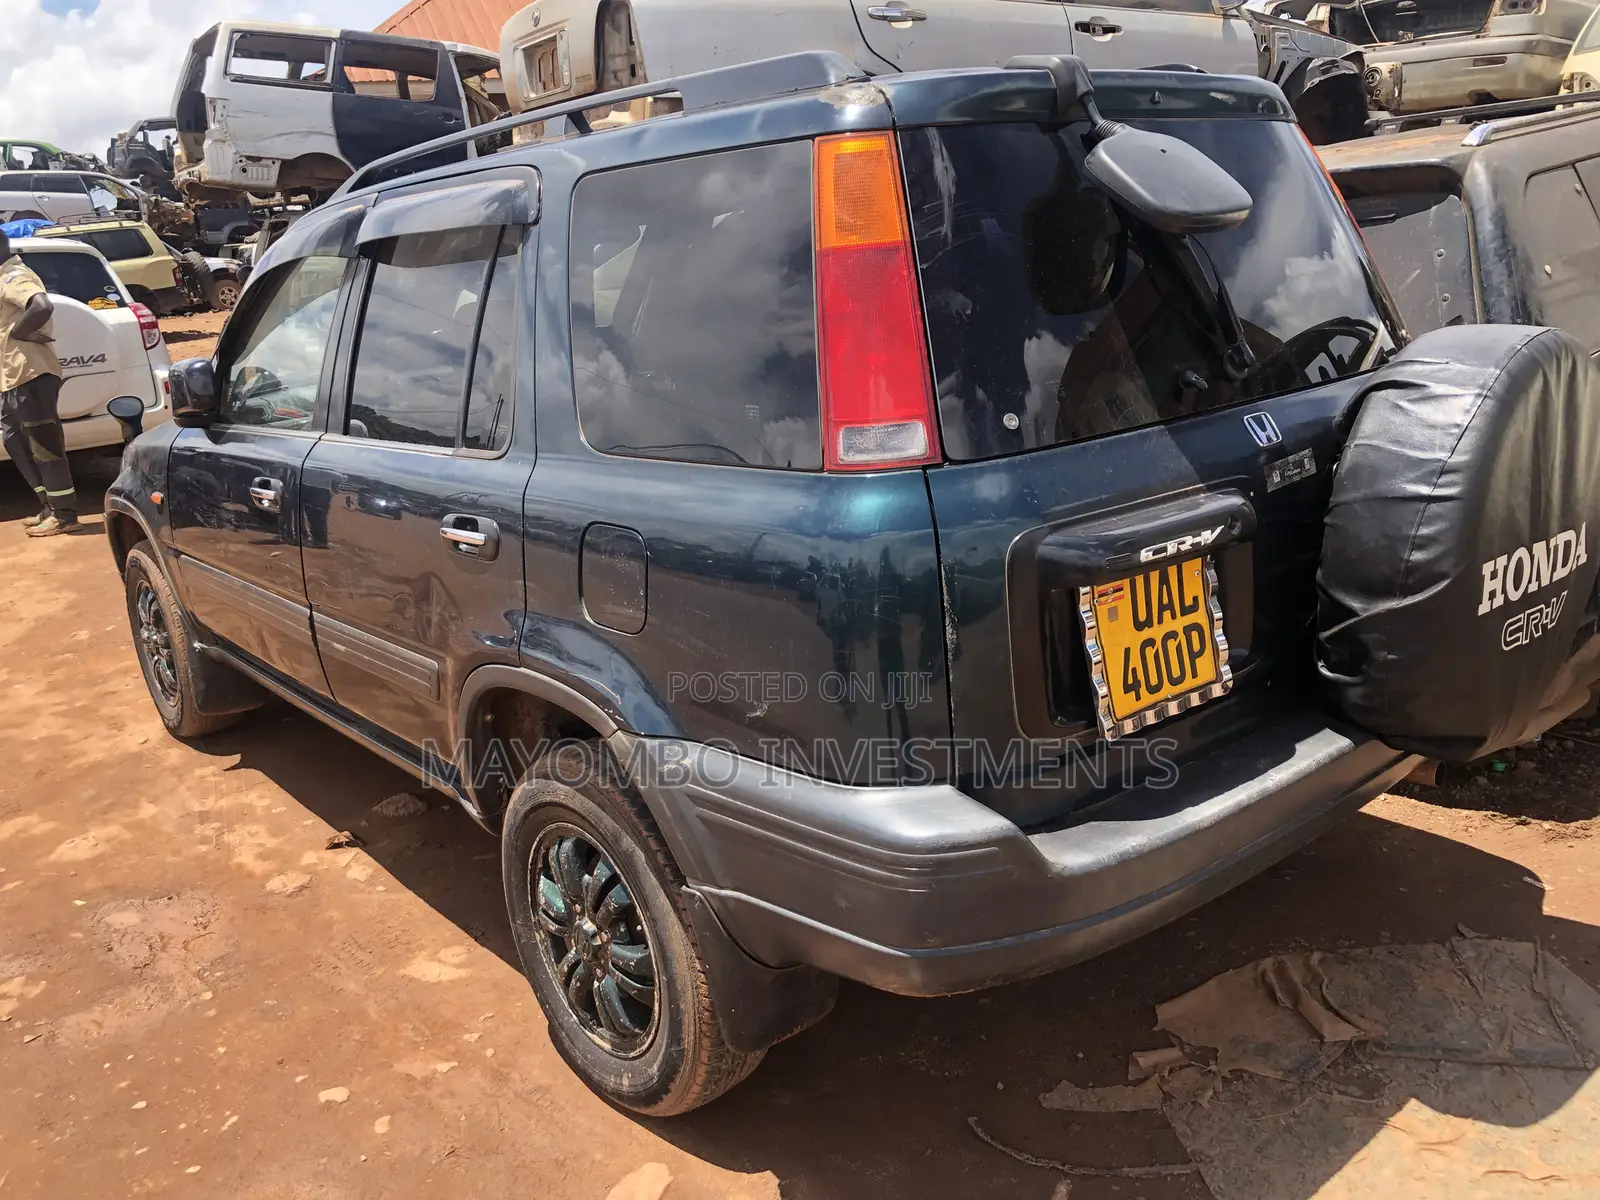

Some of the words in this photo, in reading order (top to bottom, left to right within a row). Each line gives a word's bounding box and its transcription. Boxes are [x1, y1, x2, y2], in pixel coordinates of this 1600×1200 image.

[58, 353, 108, 367] RAV4
[1139, 524, 1225, 563] CR-V
[1477, 521, 1588, 617] HONDA
[1129, 562, 1200, 632] UAL
[1501, 589, 1568, 651] CR-V
[1122, 622, 1207, 702] 400P
